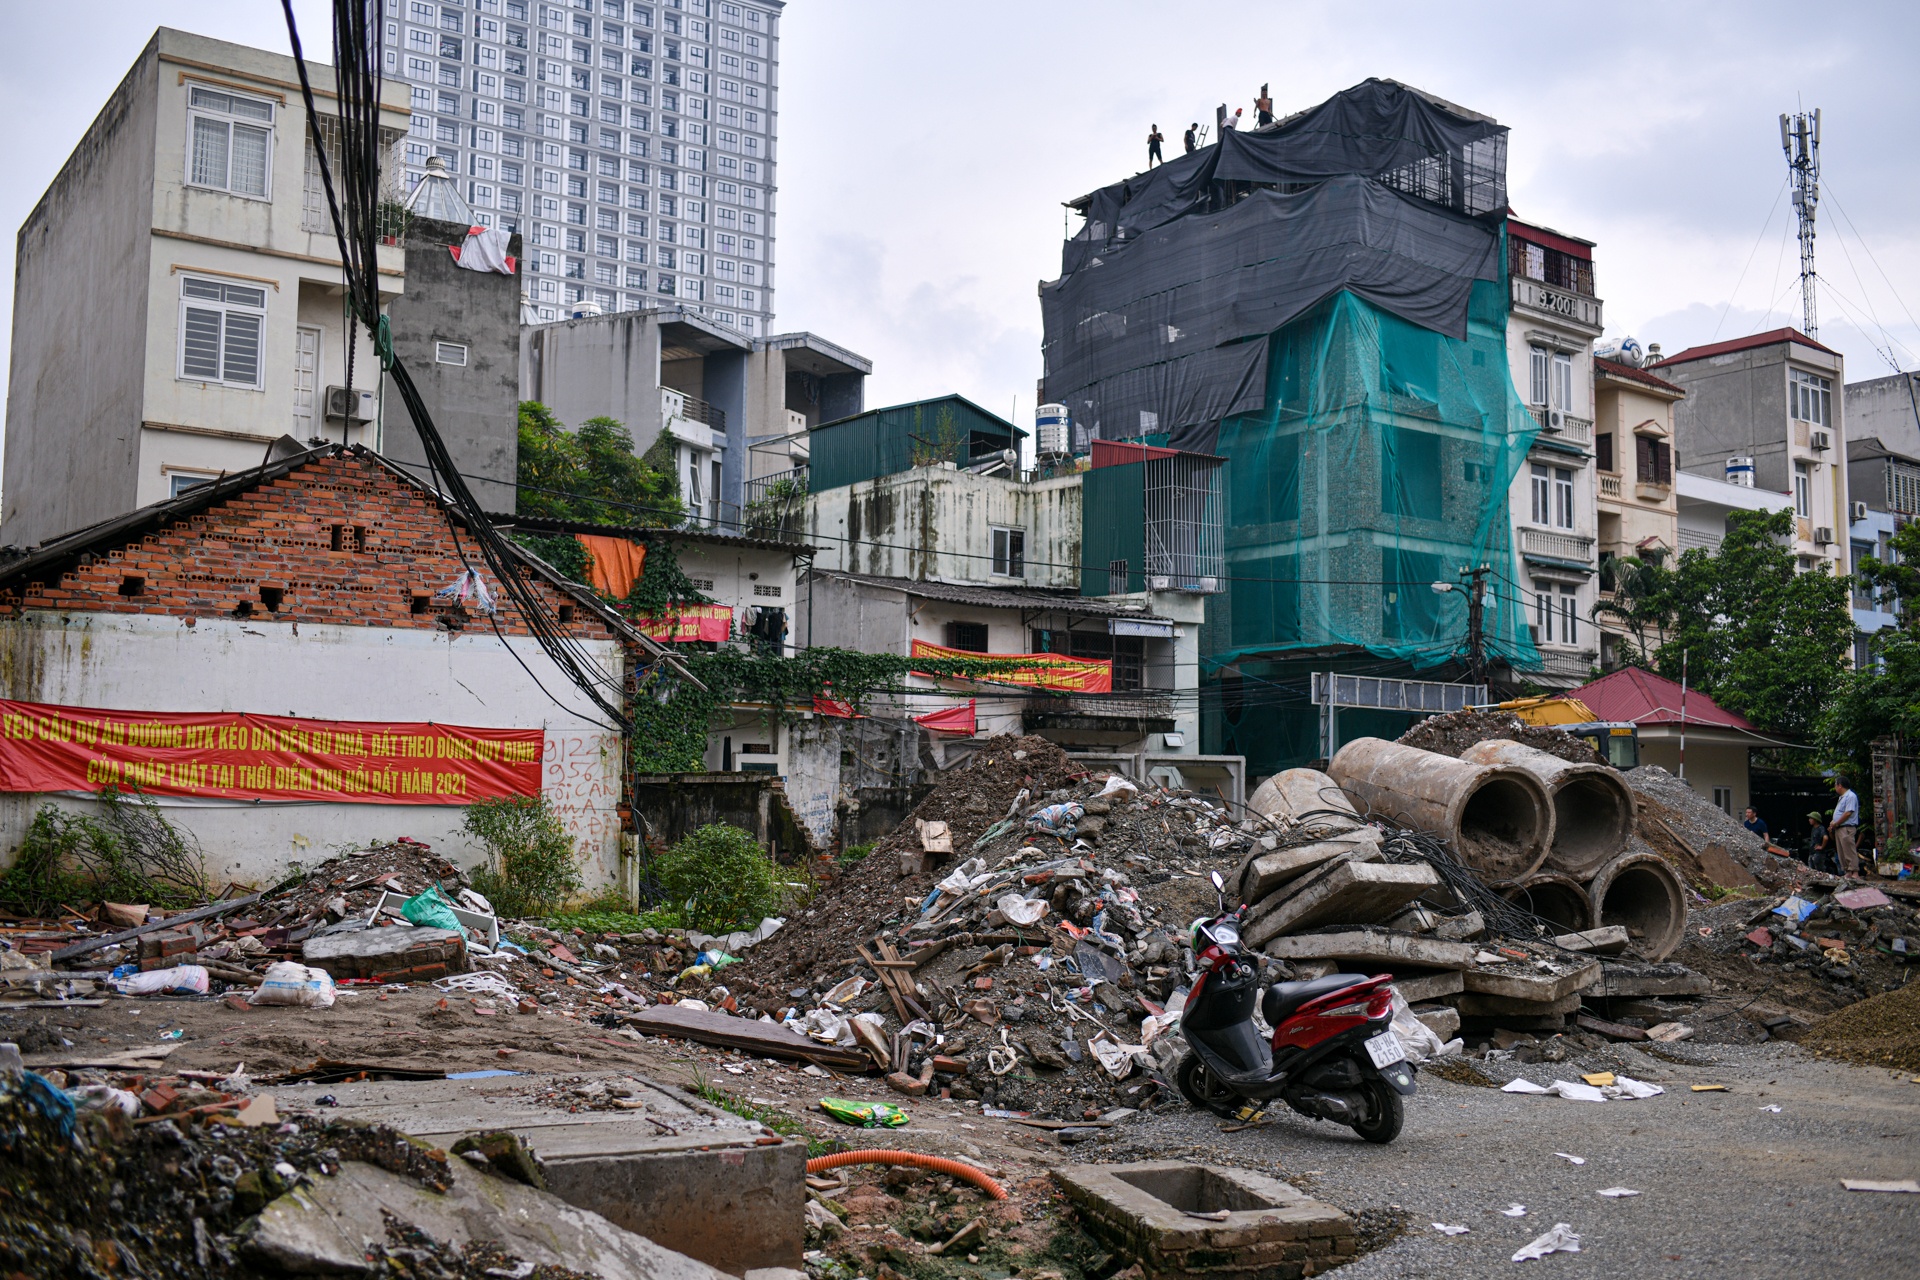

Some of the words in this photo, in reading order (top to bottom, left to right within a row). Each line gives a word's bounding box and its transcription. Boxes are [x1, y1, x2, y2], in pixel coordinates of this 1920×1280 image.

[3, 710, 34, 740] YÊU
[38, 711, 72, 743] CẦU
[75, 719, 100, 749] DỰ
[101, 717, 125, 746] ÁN
[128, 719, 183, 748] ĐƯỜNG
[185, 725, 215, 749] HTK
[218, 721, 248, 750] KÉO
[251, 724, 277, 751] DÀI
[334, 728, 369, 759] NHÀ,
[371, 726, 398, 757] ĐẤT
[400, 735, 434, 758] THEO
[437, 734, 473, 760] ĐÚNG
[475, 739, 501, 763] QUY
[503, 741, 535, 767] ĐỊNH
[87, 752, 119, 784] CỦA
[123, 757, 167, 786] PHÁP
[170, 758, 208, 793] LUẬT
[211, 764, 235, 794] TẠI
[239, 760, 272, 789] THỜI
[275, 758, 313, 791] ĐIỂM
[315, 768, 343, 792] THU
[372, 763, 399, 794] ĐẤT
[401, 767, 433, 794] NĂM
[435, 772, 467, 795] 2021
[549, 761, 597, 786] 956
[1369, 1034, 1395, 1053] 30-H4
[1377, 1046, 1402, 1065] 4150
